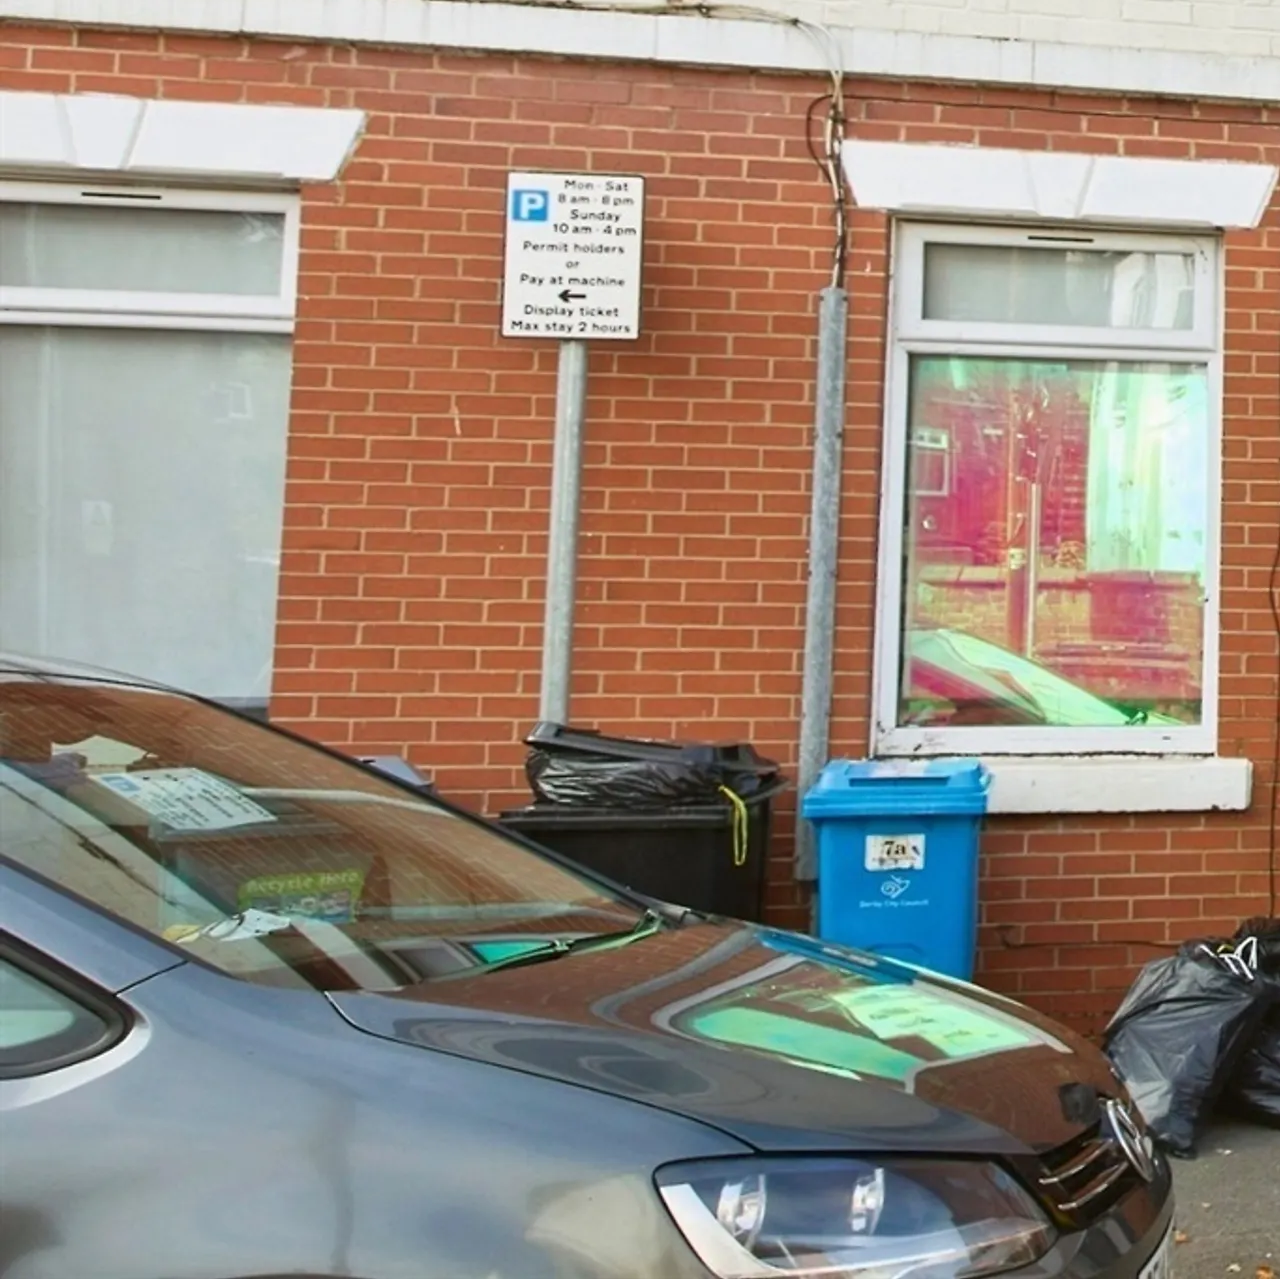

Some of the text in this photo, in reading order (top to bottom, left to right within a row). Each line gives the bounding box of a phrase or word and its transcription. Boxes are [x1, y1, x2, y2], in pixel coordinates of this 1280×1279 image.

[564, 180, 594, 191] Mon
[605, 181, 629, 192] Sat
[558, 193, 566, 204] 8
[570, 196, 590, 204] am
[613, 197, 635, 207] pm
[570, 208, 621, 222] Sunday
[553, 222, 569, 234] 10
[572, 225, 592, 234] am
[603, 225, 612, 234] 4
[615, 227, 636, 236] pm
[523, 240, 625, 254] Permit holders
[565, 261, 580, 269] or
[520, 272, 625, 286] Pay at machine
[524, 304, 619, 317] Display ticket
[510, 320, 631, 333] Max stay 2 hours
[883, 840, 906, 856] 7a
[859, 899, 929, 908] Derby City Council
